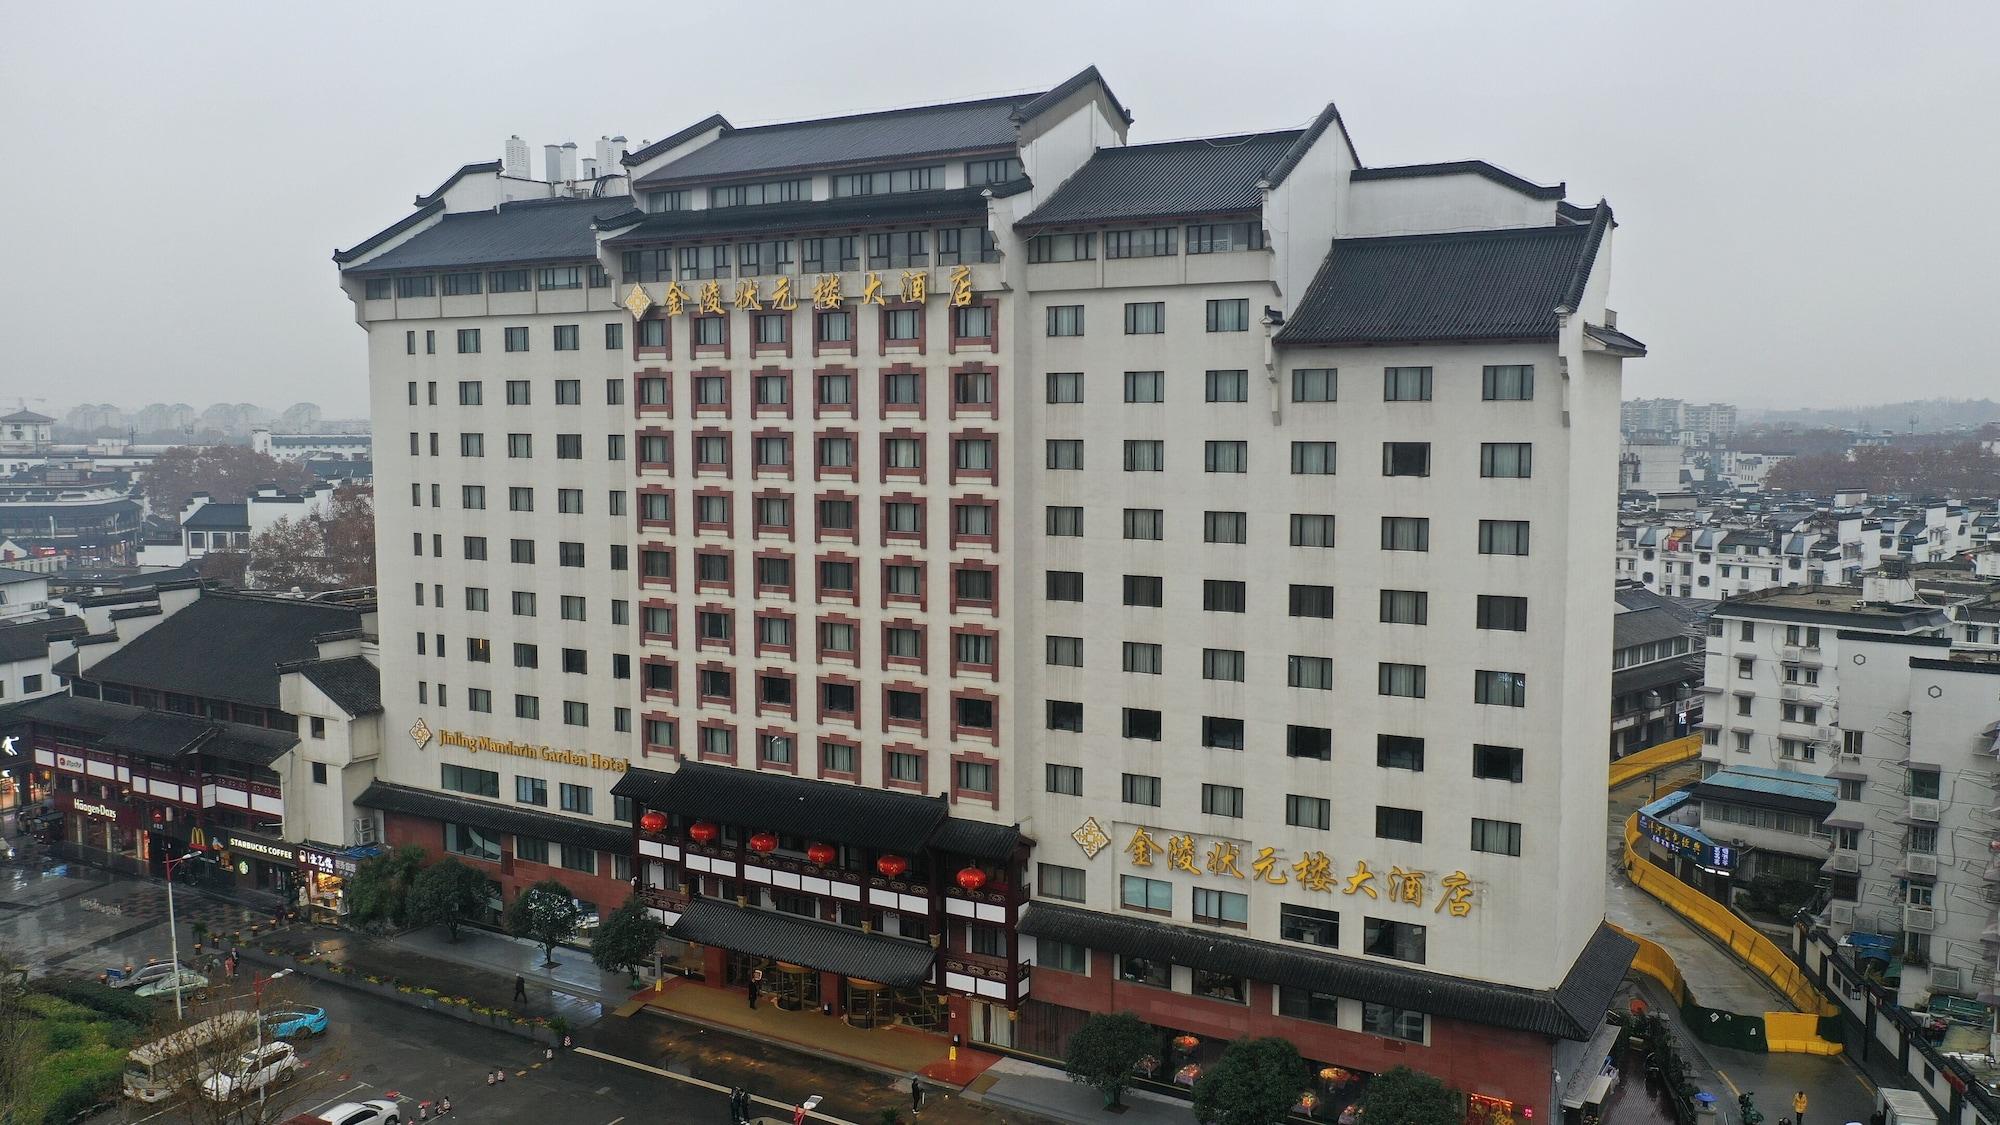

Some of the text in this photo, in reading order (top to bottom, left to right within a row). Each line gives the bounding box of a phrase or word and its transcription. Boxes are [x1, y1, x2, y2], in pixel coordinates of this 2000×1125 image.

[664, 265, 974, 317] 金陵状元楼大酒店
[438, 729, 630, 773] Jinling Mandarin Garden Hotel
[230, 838, 293, 860] STARBUCKS COFFEE
[1124, 825, 1474, 918] 金陵状元楼大酒店
